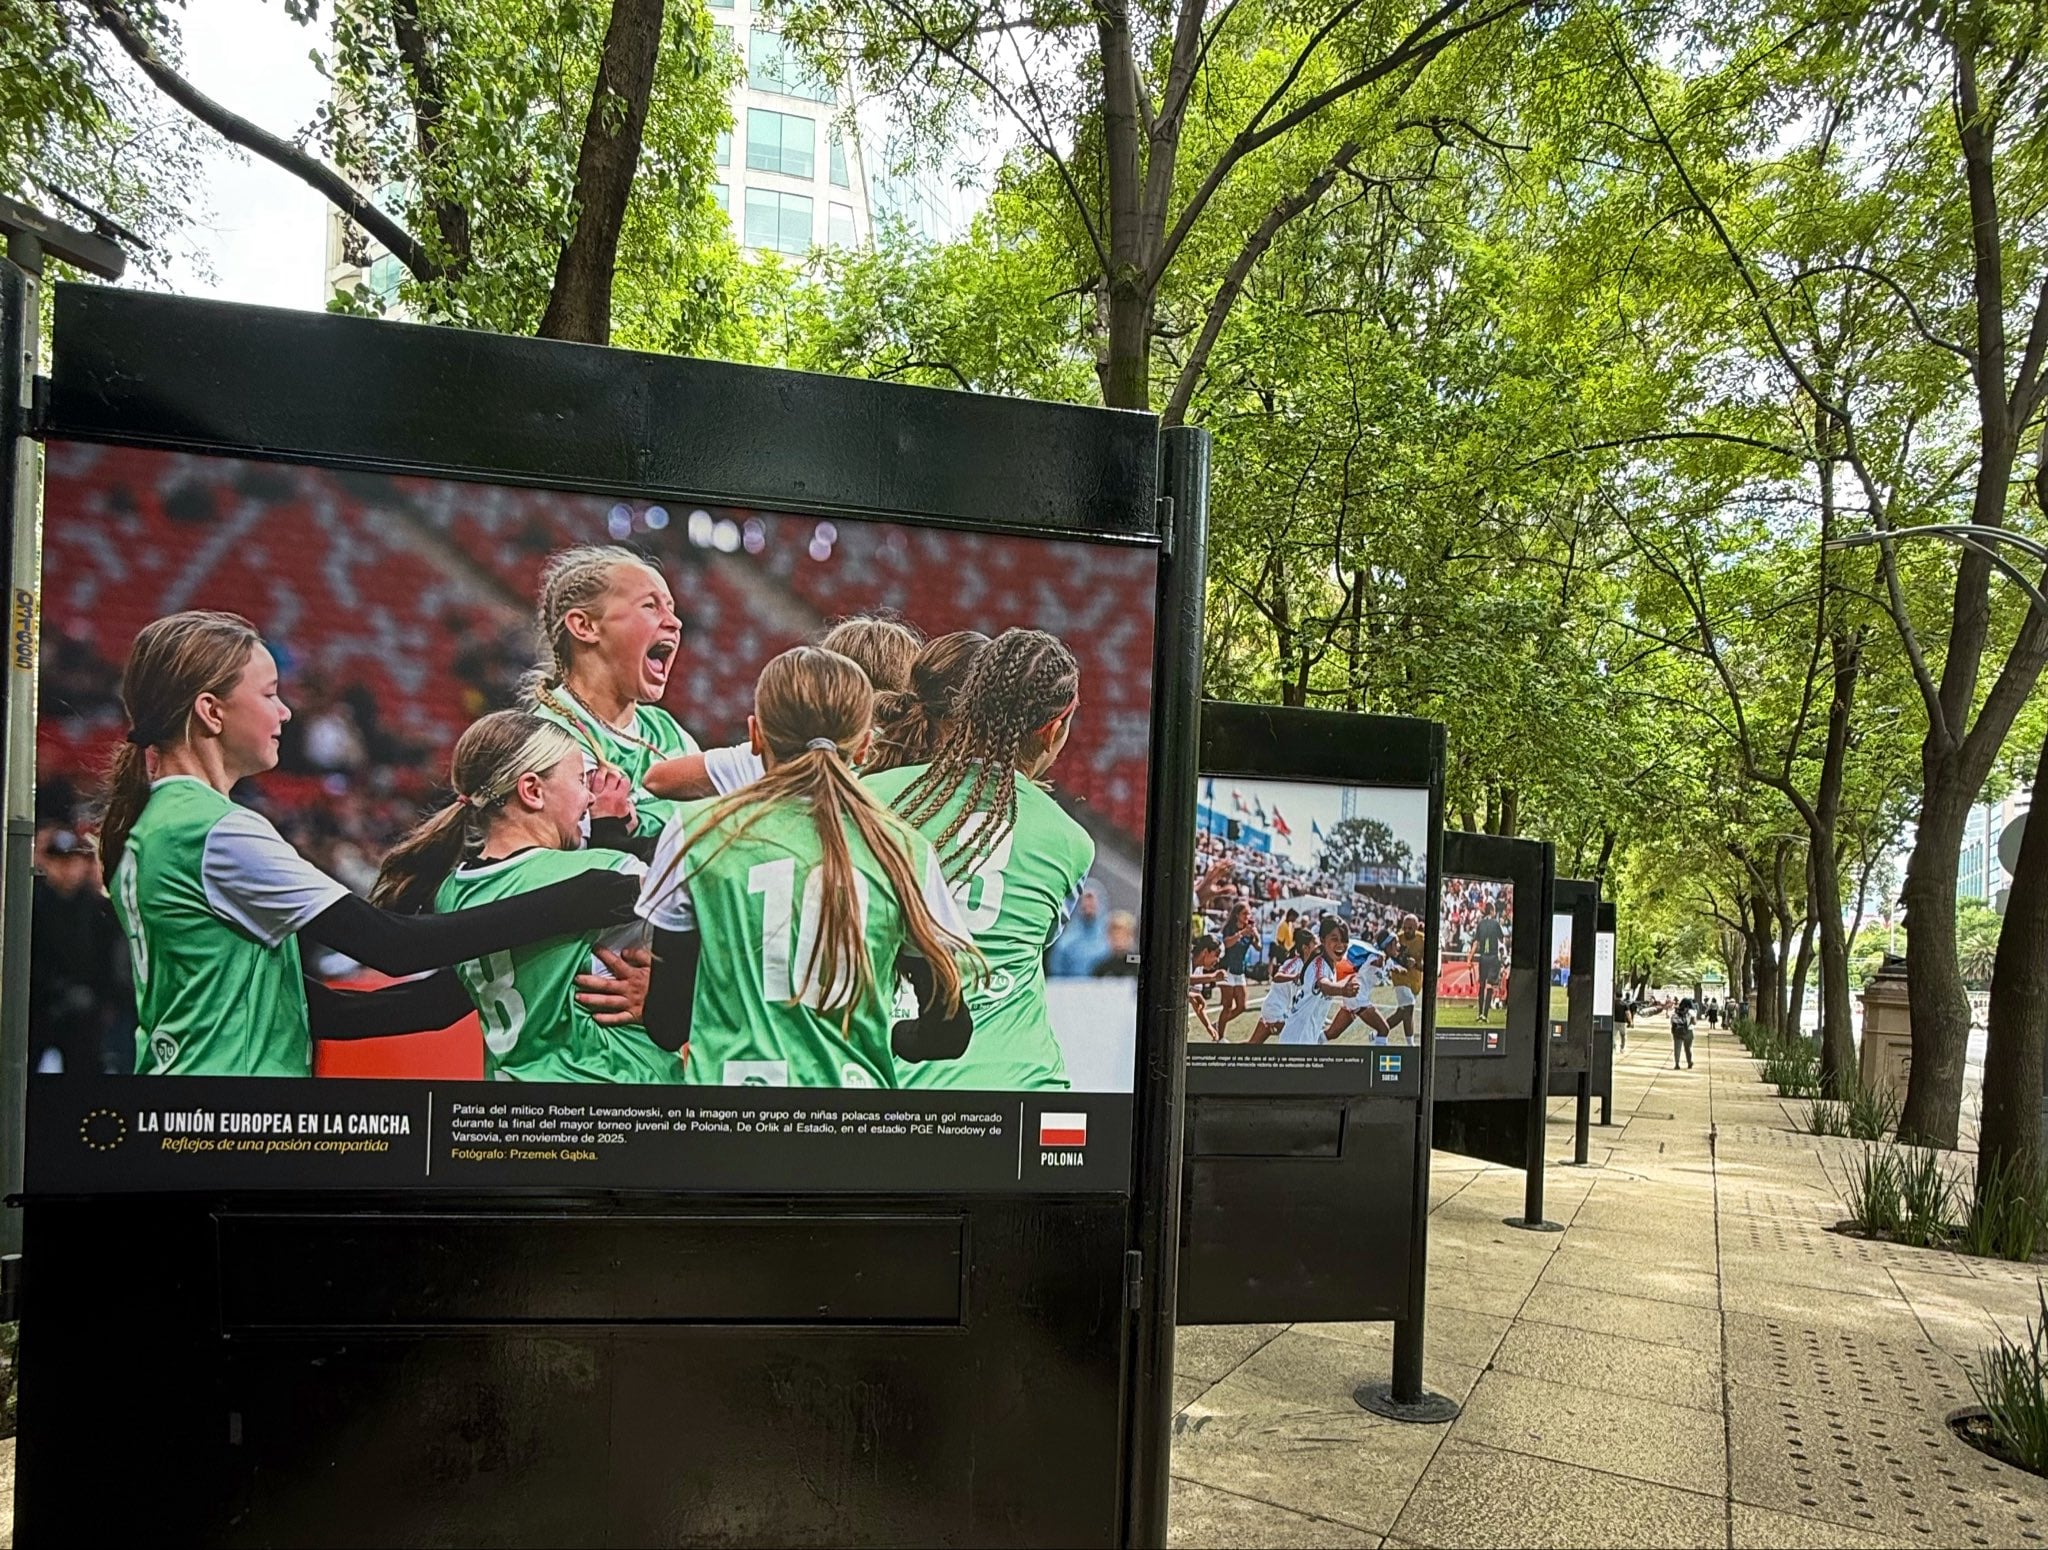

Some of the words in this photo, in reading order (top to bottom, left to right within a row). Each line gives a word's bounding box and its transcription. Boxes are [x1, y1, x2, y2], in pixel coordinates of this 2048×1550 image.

[747, 857, 870, 1010] 10
[139, 1112, 158, 1131] LA
[165, 1110, 214, 1132] UNIÓN
[220, 1113, 292, 1133] EUROPEA
[298, 1114, 318, 1133] EN
[324, 1115, 342, 1133] LA
[349, 1115, 409, 1134] CANCHA
[452, 1103, 486, 1115] Patria
[489, 1104, 507, 1115] del
[548, 1105, 585, 1116] Robert
[589, 1106, 663, 1119] Lewandowski,
[667, 1109, 682, 1118] en
[685, 1107, 696, 1118] la
[699, 1108, 738, 1121] imagen
[742, 1110, 756, 1119] un
[759, 1111, 790, 1121] grupo
[792, 1109, 807, 1120] de
[810, 1110, 838, 1121] niñas
[841, 1110, 881, 1122] polacas
[883, 1111, 921, 1122] celebra
[924, 1113, 938, 1122] un
[940, 1112, 957, 1124] gol
[960, 1113, 1003, 1123] marcado
[451, 1117, 495, 1129] durante
[498, 1118, 509, 1129] la
[512, 1118, 536, 1129] final
[538, 1119, 557, 1129] del
[559, 1121, 594, 1132] mayor
[597, 1120, 632, 1131] torneo
[634, 1120, 670, 1133] juvenil
[672, 1121, 687, 1131] de
[690, 1121, 733, 1133] Polonia,
[736, 1121, 752, 1132] De
[755, 1122, 780, 1133] Orlik
[783, 1122, 793, 1133] al
[796, 1122, 837, 1134] Estadio,
[840, 1125, 854, 1134] en
[857, 1123, 867, 1134] el
[870, 1124, 907, 1135] estadio
[910, 1124, 934, 1135] PGE
[937, 1124, 986, 1137] Narodowy
[988, 1125, 1002, 1135] de
[162, 1137, 214, 1152] Reflejos
[217, 1139, 235, 1150] de
[237, 1141, 264, 1150] una
[266, 1139, 311, 1153] pasión
[314, 1140, 388, 1154] compartida
[451, 1131, 502, 1143] Varsovia,
[504, 1134, 520, 1142] en
[521, 1132, 579, 1143] noviembre
[580, 1133, 595, 1143] de
[597, 1133, 627, 1144] 2025.
[451, 1148, 507, 1161] Fotógrafo:
[509, 1148, 558, 1160] Przemek
[1041, 1152, 1084, 1166] POLONIA
